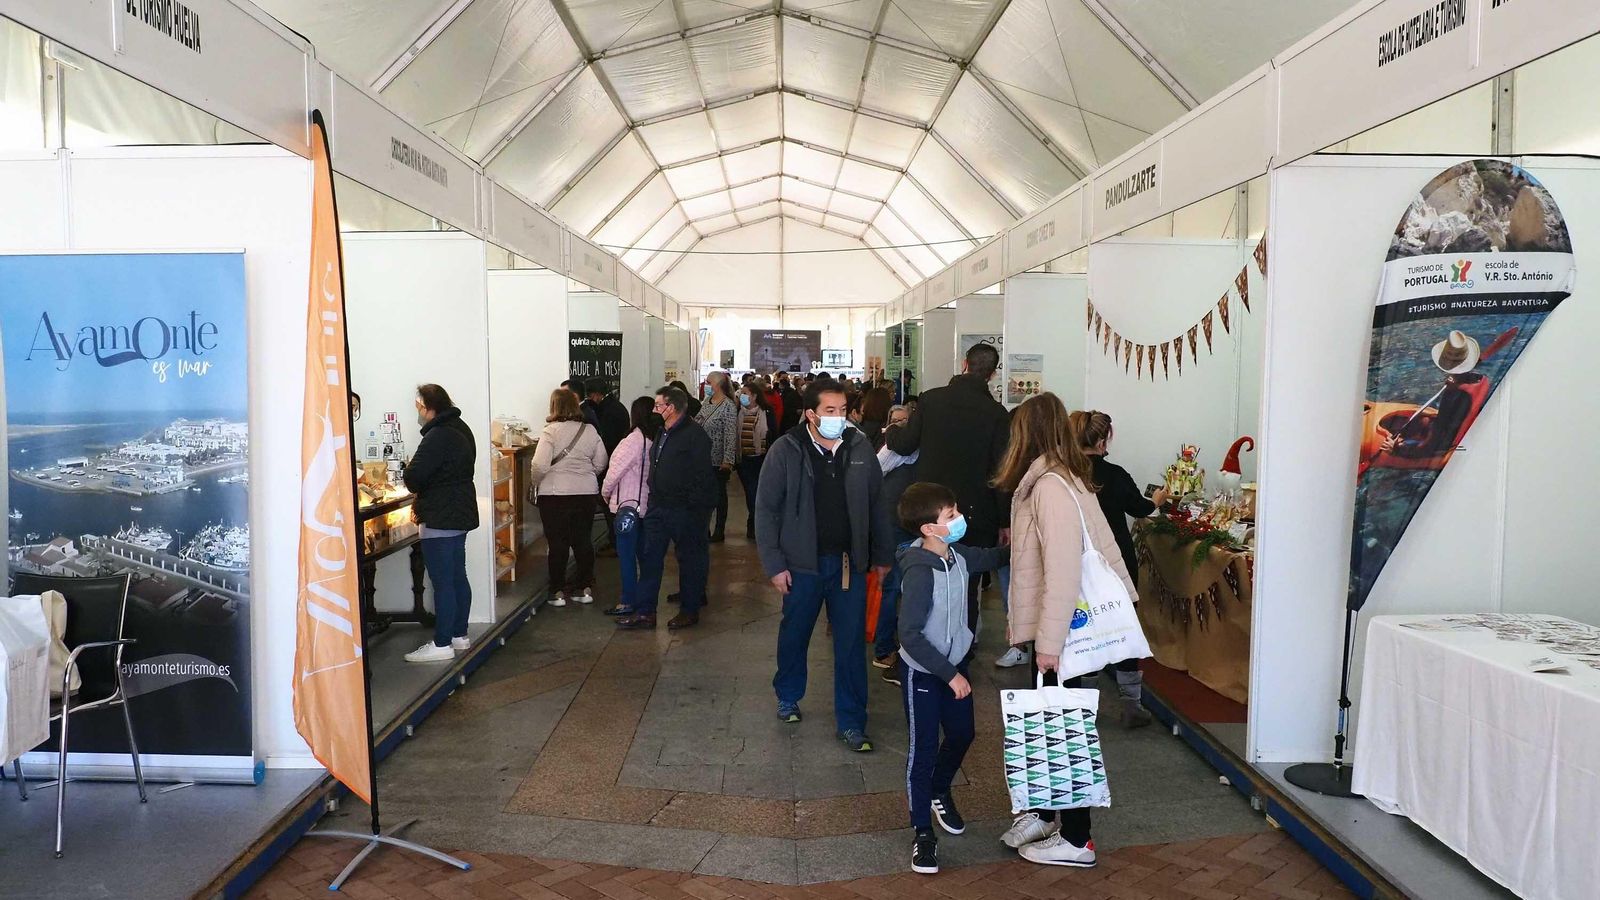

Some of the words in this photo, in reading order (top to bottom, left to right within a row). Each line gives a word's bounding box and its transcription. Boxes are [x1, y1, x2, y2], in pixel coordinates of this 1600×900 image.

[174, 0, 201, 54] HUELVA
[1378, 28, 1397, 67] ESCOLA
[1398, 23, 1405, 58] DE
[1405, 7, 1434, 54] HOTELARIA
[1441, 0, 1467, 36] TURISMO
[1105, 163, 1156, 210] PANDULZARTE
[1407, 264, 1435, 275] TURISMO
[1435, 263, 1444, 271] DE
[1484, 260, 1508, 270] escola
[1509, 260, 1519, 269] de
[1404, 275, 1448, 287] PORTUGAL
[1484, 272, 1502, 282] V.R.
[1503, 272, 1520, 281] Sto.
[1521, 271, 1554, 281] António
[1408, 302, 1447, 313] #TURISMO
[1451, 300, 1498, 309] #NATUREZA
[570, 337, 590, 348] quinta
[152, 359, 171, 383] es
[178, 358, 213, 379] mar
[1087, 600, 1121, 618] BERRY
[121, 661, 231, 678] ayamonteturismo.es
